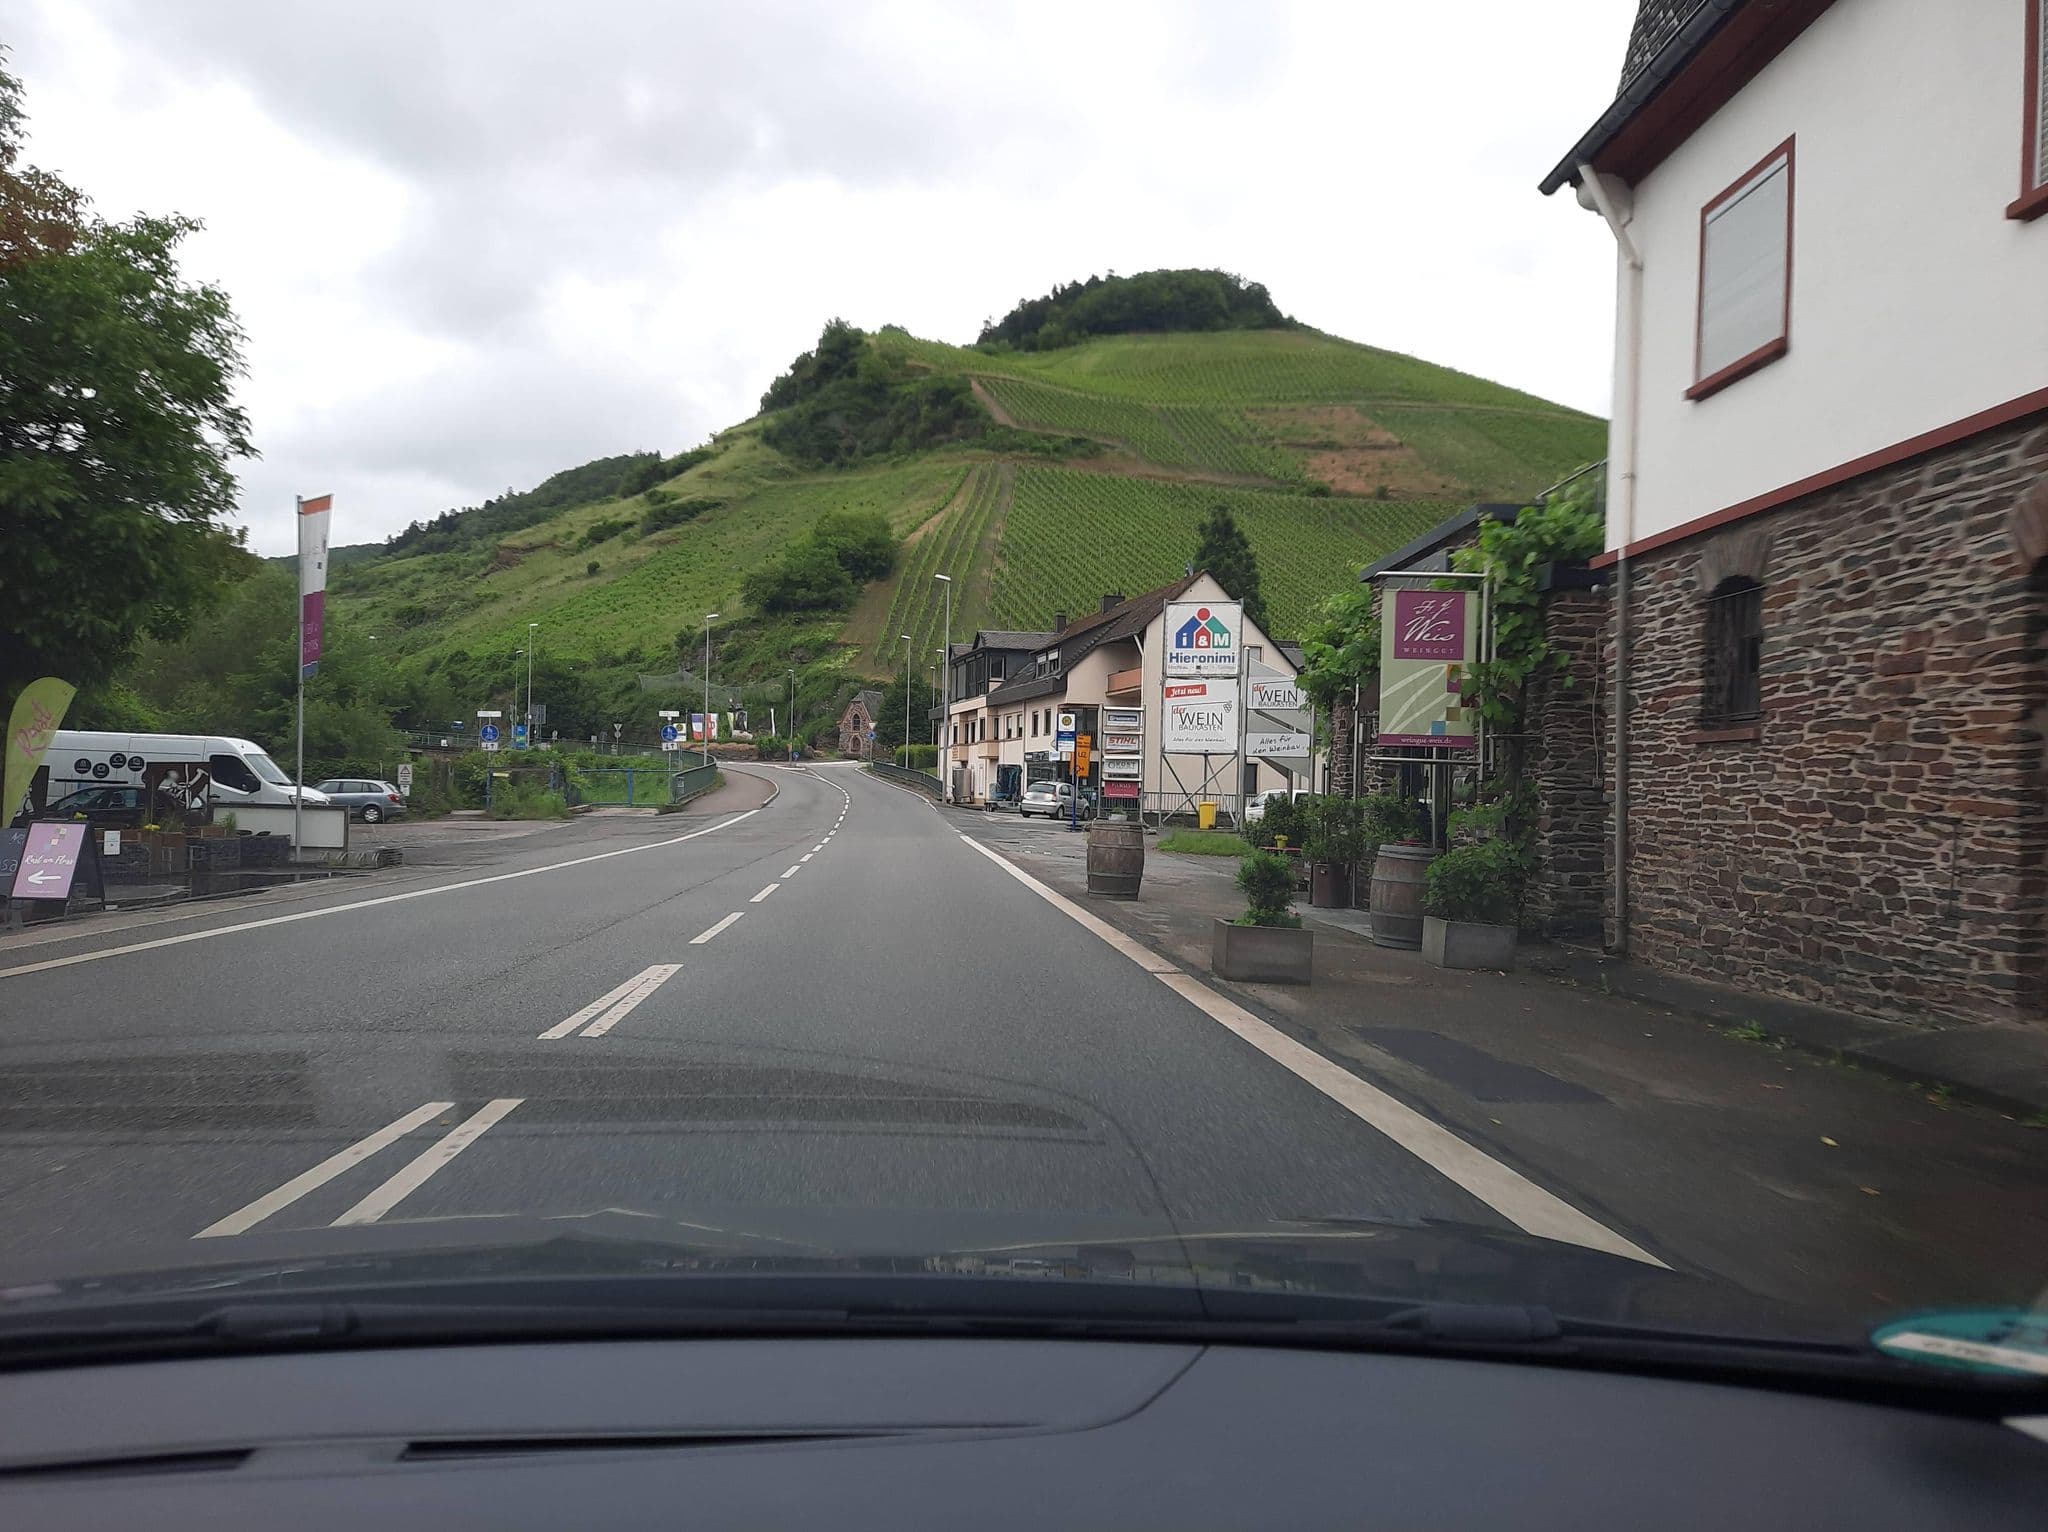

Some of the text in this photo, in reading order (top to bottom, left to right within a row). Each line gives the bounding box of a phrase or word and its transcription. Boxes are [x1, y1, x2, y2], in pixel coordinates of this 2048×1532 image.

[1402, 616, 1456, 642] Weis
[1169, 652, 1235, 663] Hieronimi
[1170, 687, 1186, 697] Jetzt
[1253, 684, 1266, 692] der
[1259, 689, 1298, 703] WEIN
[1173, 706, 1187, 715] der
[1180, 712, 1223, 726] WEIN
[1108, 736, 1137, 745] STIHL
[1259, 737, 1277, 745] Alles
